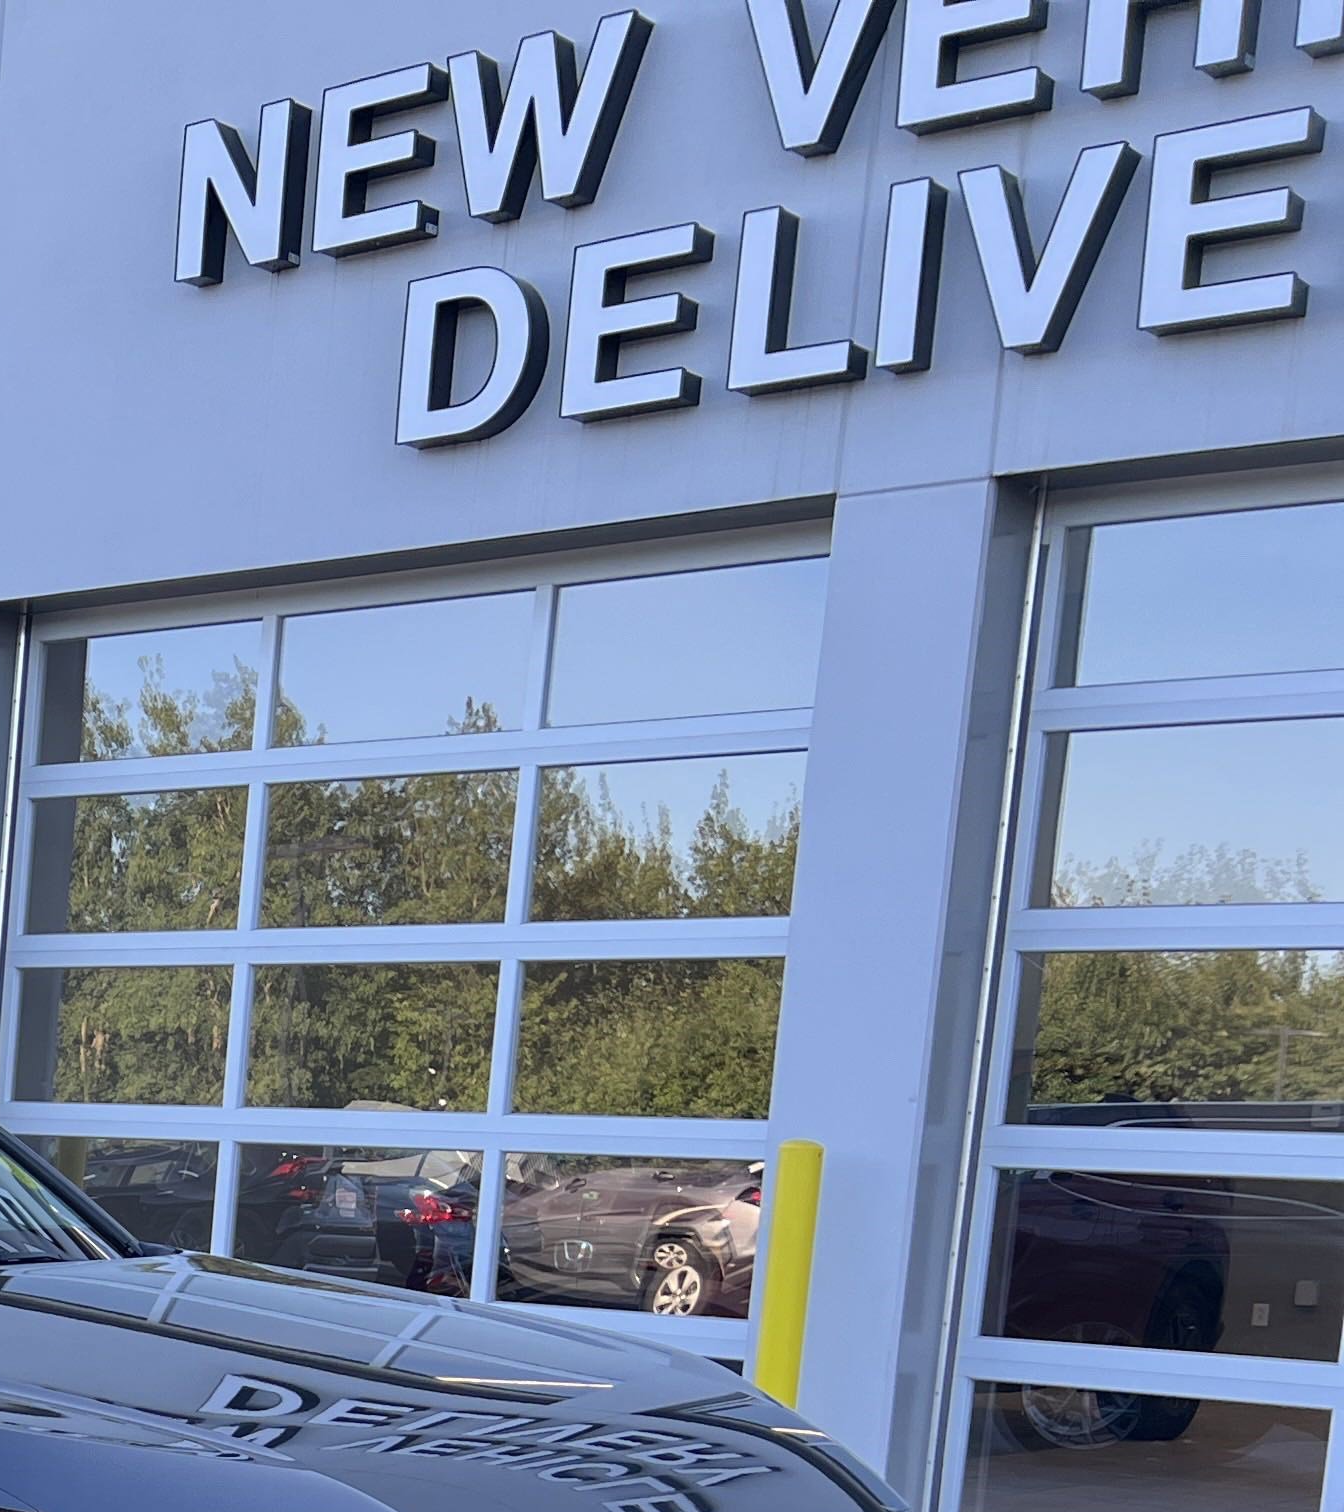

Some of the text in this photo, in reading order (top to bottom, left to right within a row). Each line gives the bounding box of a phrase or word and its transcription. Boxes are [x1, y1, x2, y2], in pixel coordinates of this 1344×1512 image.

[174, 0, 1344, 287] NEW VE
[394, 105, 1324, 450] DELIVE
